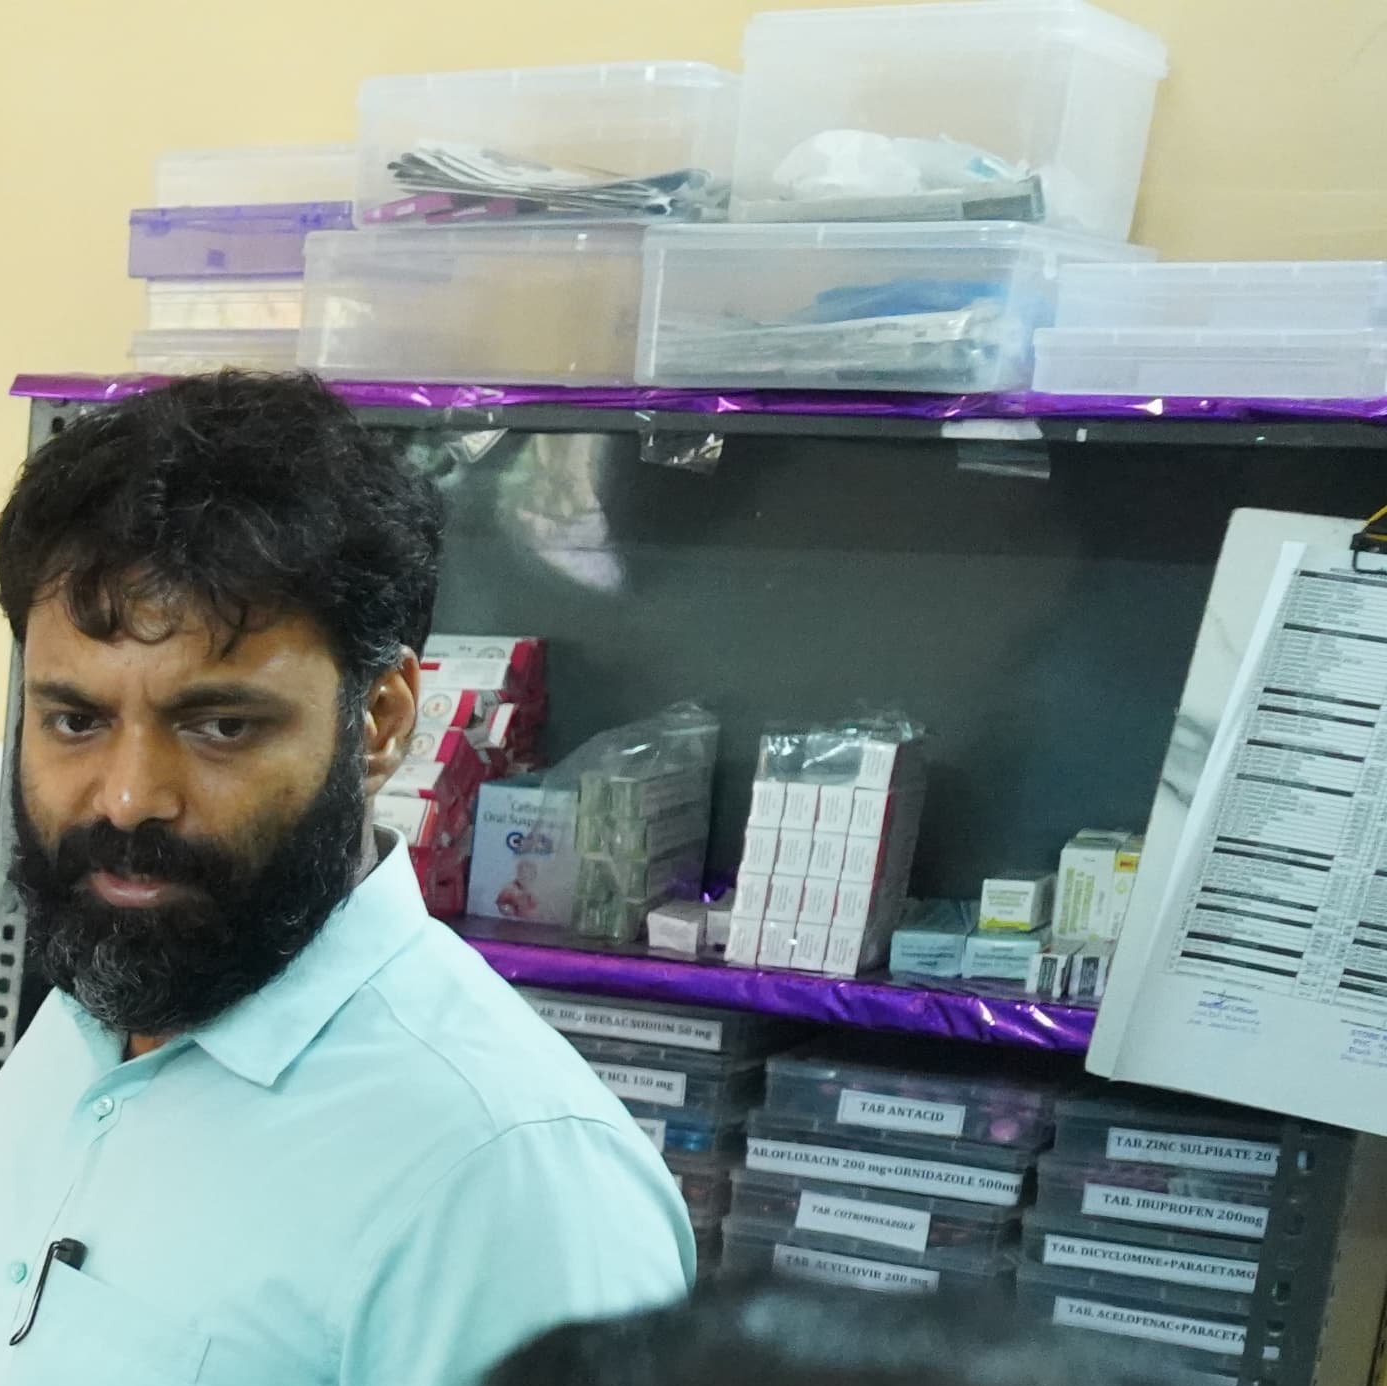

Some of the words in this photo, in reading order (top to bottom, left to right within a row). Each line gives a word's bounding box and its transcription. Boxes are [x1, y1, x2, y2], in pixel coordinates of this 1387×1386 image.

[631, 1018, 675, 1034] SODIUM
[695, 1029, 713, 1041] mg
[633, 1074, 654, 1087] 150
[656, 1079, 675, 1092] mg
[860, 1101, 885, 1114] TAB
[887, 1105, 945, 1123] ANTACID
[1180, 1143, 1251, 1160] SULPHATE
[1255, 1151, 1272, 1162] 20
[842, 1158, 866, 1170] 200
[978, 1176, 1022, 1194] 500mg
[1136, 1196, 1214, 1218] IBUPROFEN
[1216, 1209, 1264, 1229] 200mg
[814, 1258, 882, 1281] ACYCLOVIR
[884, 1271, 908, 1285] 200
